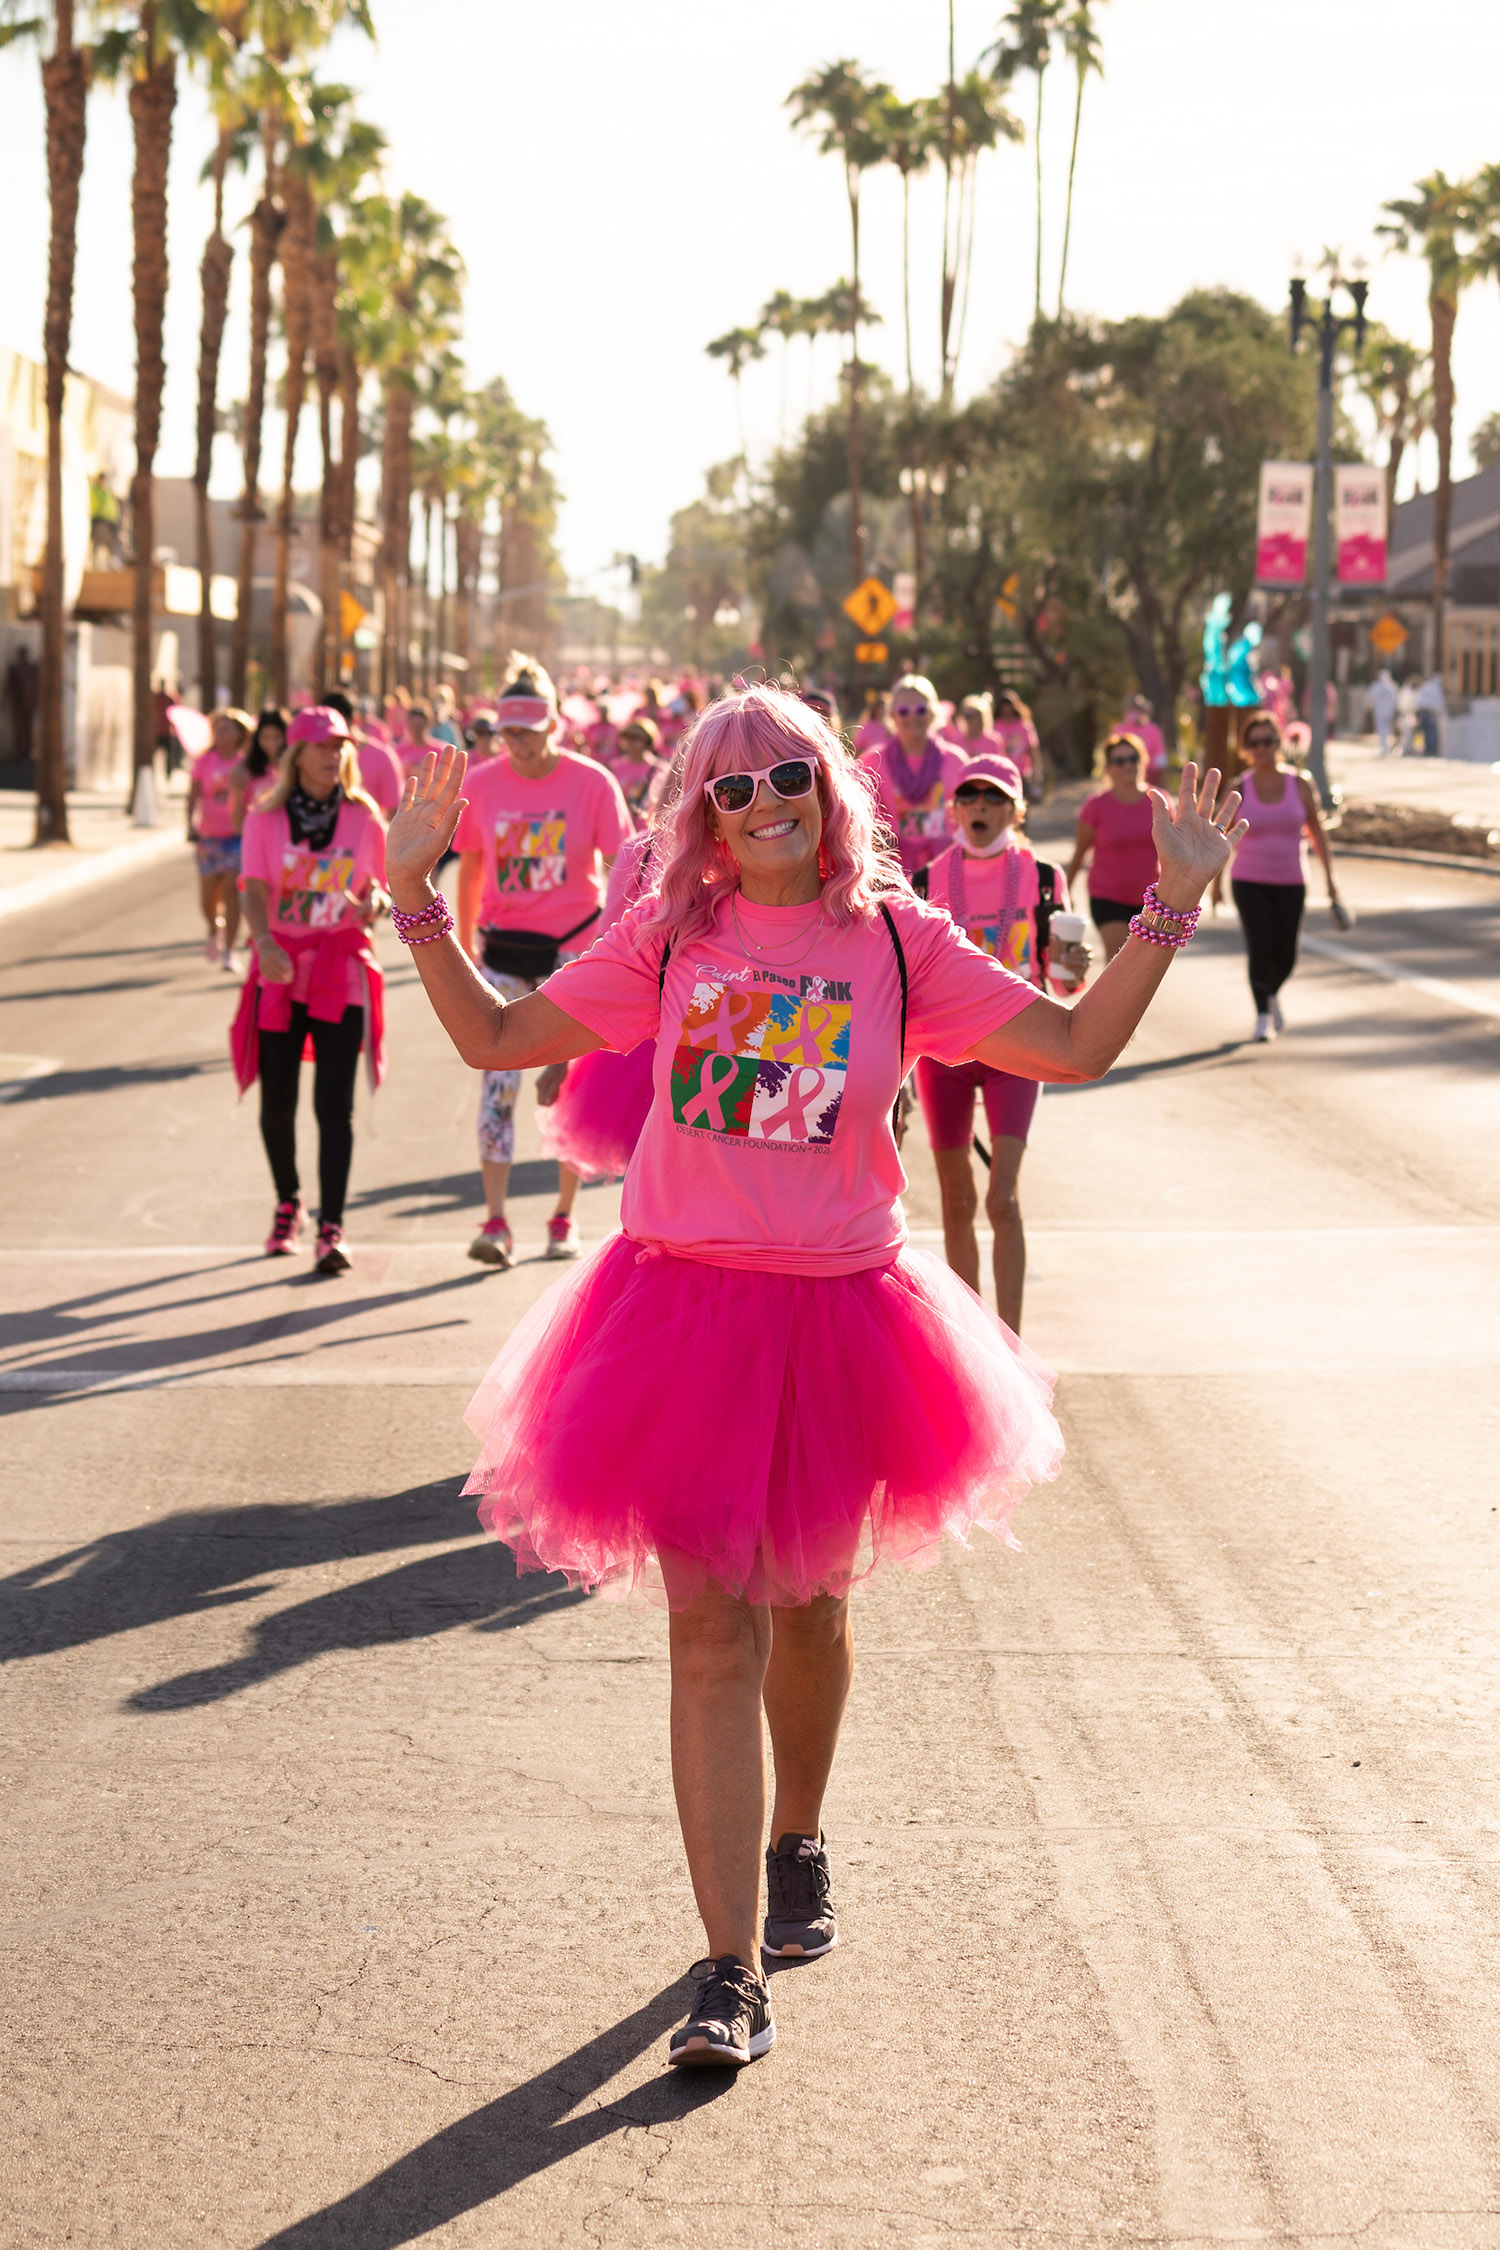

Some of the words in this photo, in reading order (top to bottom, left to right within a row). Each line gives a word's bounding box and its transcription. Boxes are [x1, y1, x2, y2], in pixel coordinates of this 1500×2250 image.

[695, 963, 752, 982] Paint
[800, 974, 853, 1003] PNK
[676, 1124, 705, 1139] DESERT
[707, 1131, 741, 1147] CANCER
[743, 1138, 807, 1154] FOUNDATION
[813, 1145, 831, 1155] 2021
